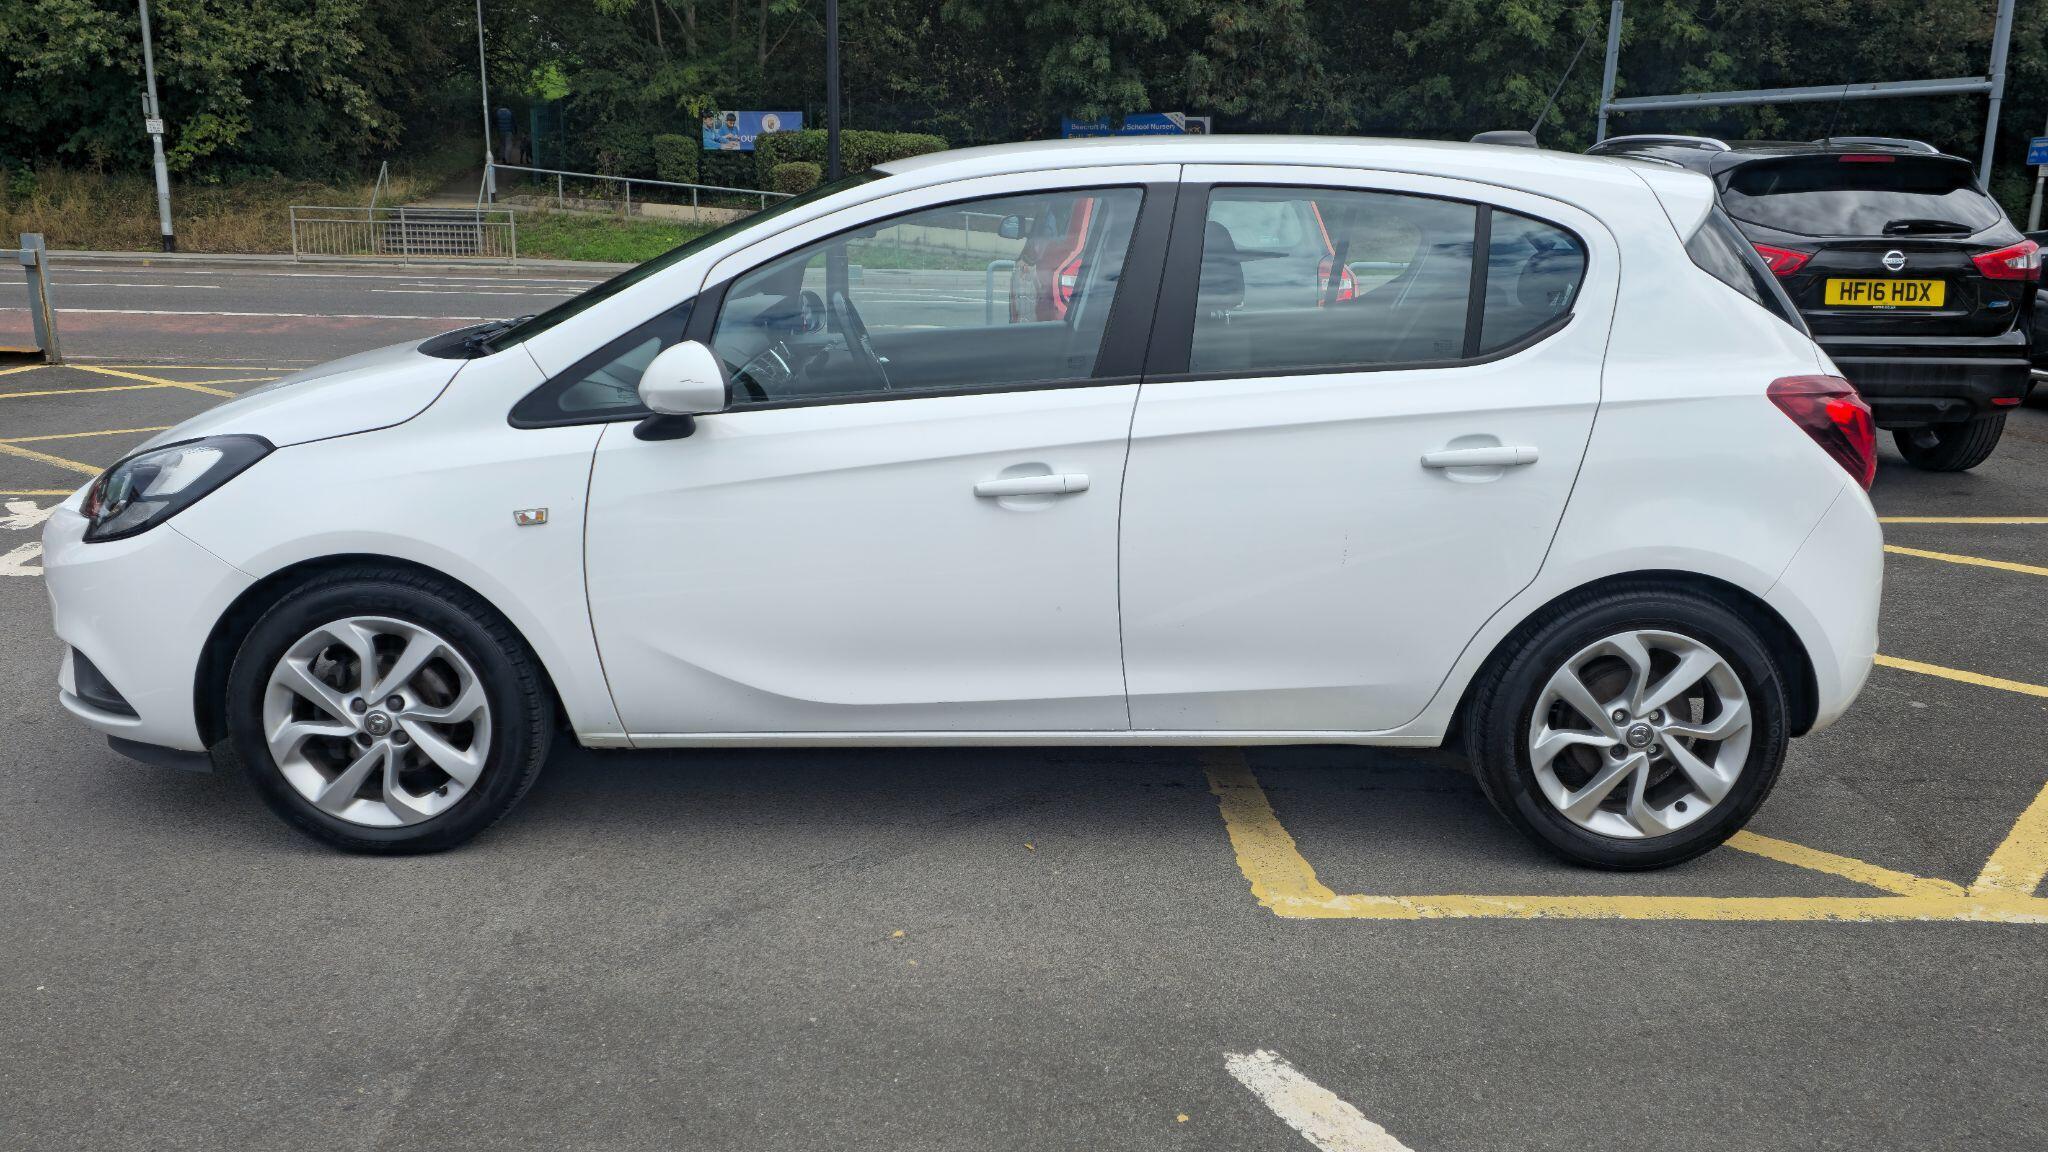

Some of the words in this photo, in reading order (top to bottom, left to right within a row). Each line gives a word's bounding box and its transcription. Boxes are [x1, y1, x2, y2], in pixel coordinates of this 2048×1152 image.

[1150, 123, 1176, 131] Nursery
[1840, 282, 1886, 301] HF16
[1891, 283, 1932, 302] HDX
